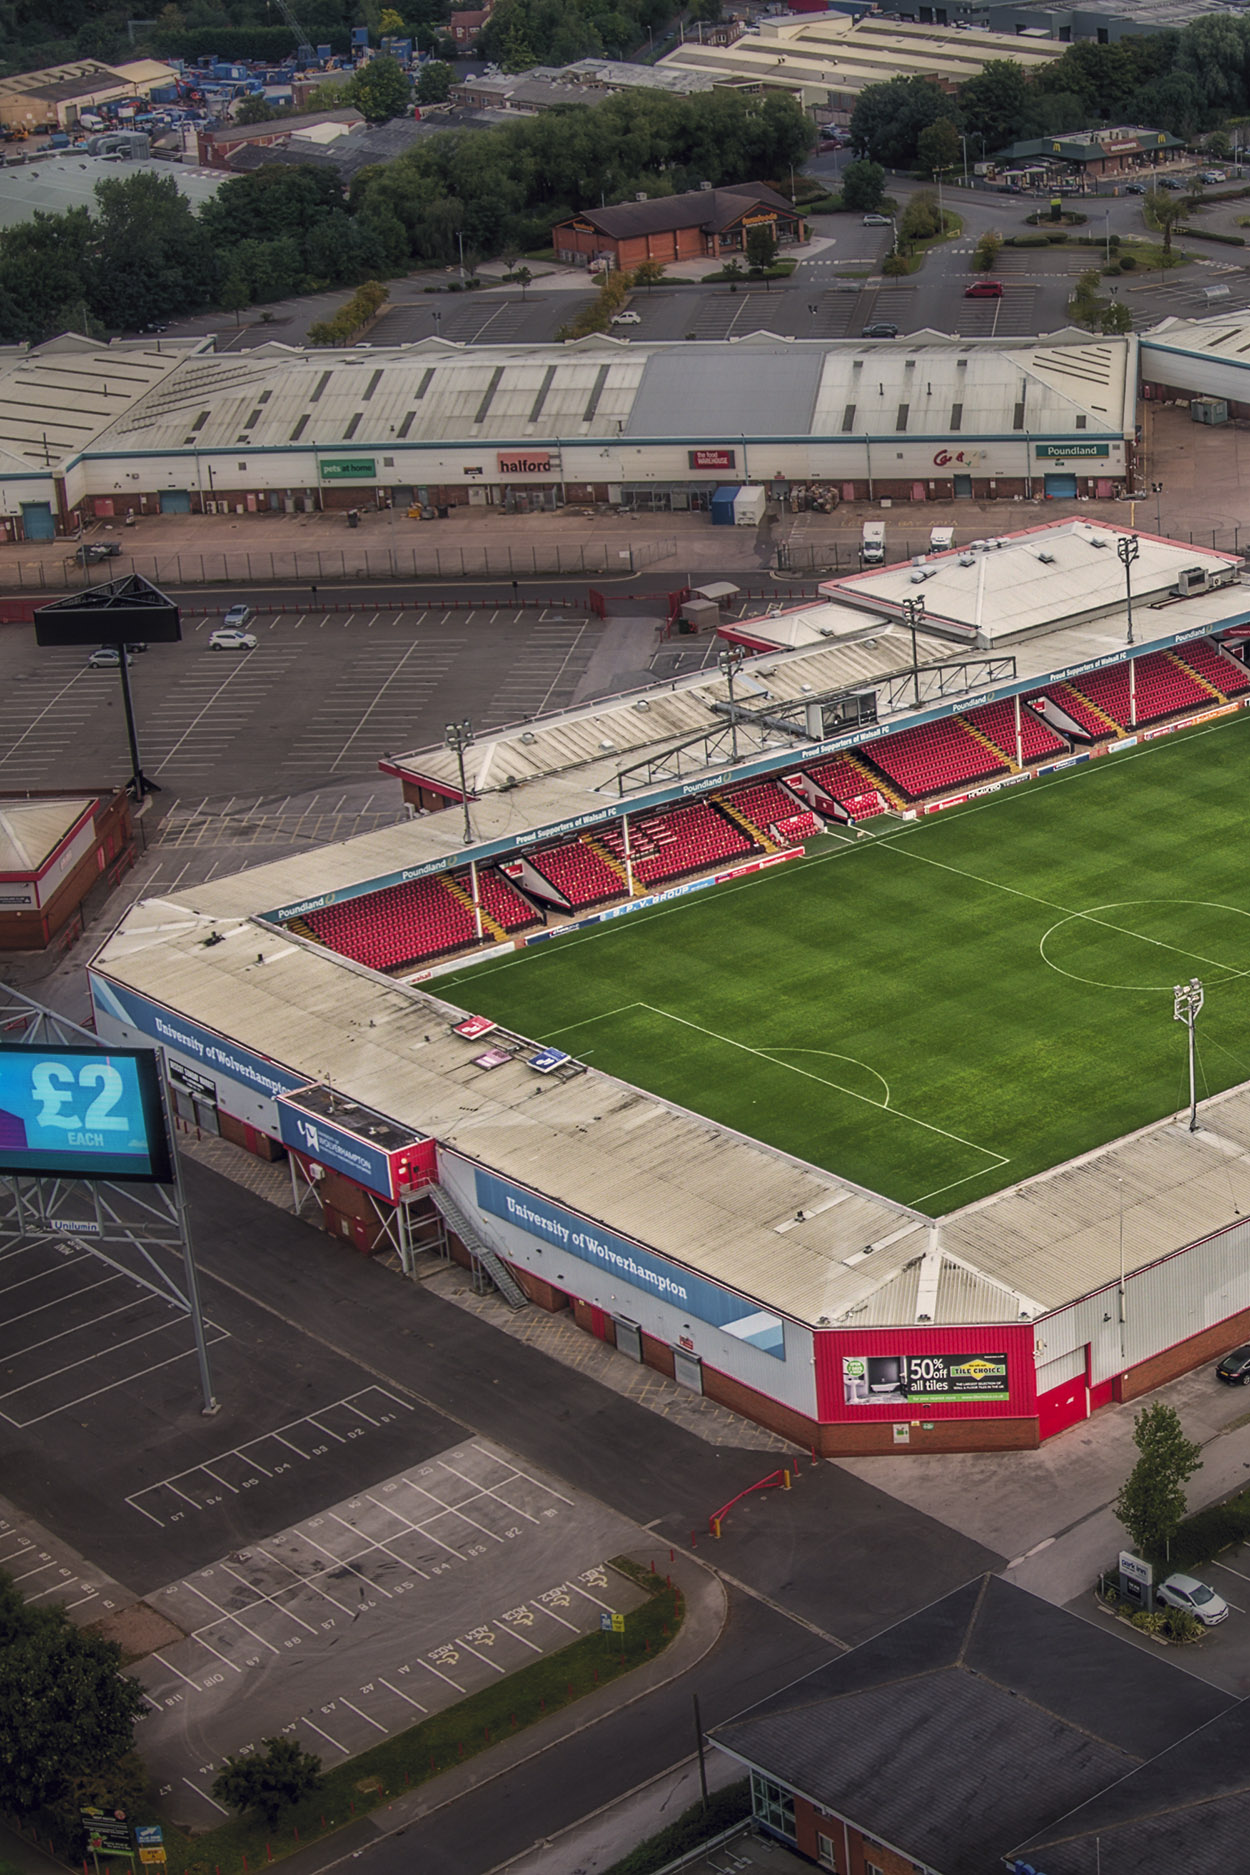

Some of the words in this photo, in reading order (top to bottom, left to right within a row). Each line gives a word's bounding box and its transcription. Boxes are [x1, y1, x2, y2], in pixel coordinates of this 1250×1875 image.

[1048, 447, 1097, 455] Poundland
[323, 464, 341, 473] pets
[342, 464, 350, 472] at
[351, 464, 372, 472] home
[1175, 627, 1206, 643] Poundland
[1050, 671, 1065, 681] Proud
[1066, 662, 1094, 676] Supporters
[1101, 654, 1119, 665] Walsall
[952, 695, 987, 712] Poundland
[802, 747, 819, 758] Proud
[821, 738, 852, 753] Supporters
[853, 735, 859, 743] of
[860, 728, 880, 740] Walsall
[683, 776, 722, 794] Poundland
[516, 831, 536, 844] Proud
[537, 822, 574, 837] Supporters
[575, 818, 582, 826] of
[582, 810, 607, 824] Walsall
[608, 808, 616, 816] FC
[402, 859, 447, 880] Poundland
[652, 886, 689, 904] GROUP
[278, 897, 324, 919] Poundland
[155, 1017, 204, 1057] University
[205, 1046, 216, 1060] of
[32, 1061, 129, 1131] £2
[67, 1132, 104, 1147] EACH
[54, 1221, 97, 1231] Unilumin
[506, 1196, 569, 1243] University
[572, 1232, 586, 1248] of
[584, 1238, 687, 1300] Wolverhampton
[933, 1369, 947, 1378] off
[911, 1380, 923, 1391] all
[926, 1380, 948, 1390] tiles
[380, 1412, 397, 1423] D1
[347, 1428, 365, 1439] D2
[312, 1444, 328, 1456] D3
[274, 1462, 292, 1475] D4
[242, 1478, 259, 1489] D5
[206, 1495, 223, 1505] D6
[170, 1512, 186, 1522] D7
[505, 1526, 522, 1538] B2
[467, 1544, 487, 1557] B3
[432, 1563, 451, 1575] B4
[577, 1564, 606, 1582] ACC1
[394, 1580, 415, 1594] B5
[537, 1583, 569, 1602] ACC2
[358, 1600, 376, 1612] B6
[502, 1604, 529, 1621] ACC3
[320, 1618, 337, 1631] B7
[464, 1624, 489, 1641] ACC4
[284, 1635, 302, 1649] B8
[427, 1643, 454, 1661] ACC5
[246, 1656, 260, 1667] B9
[398, 1664, 410, 1675] A1
[203, 1673, 225, 1689] B10
[360, 1683, 374, 1695] A2
[165, 1694, 184, 1707] B11
[320, 1700, 337, 1715] A3
[282, 1722, 296, 1734] A4
[239, 1744, 255, 1755] A5
[199, 1762, 215, 1775] A6
[158, 1783, 173, 1797] A7
